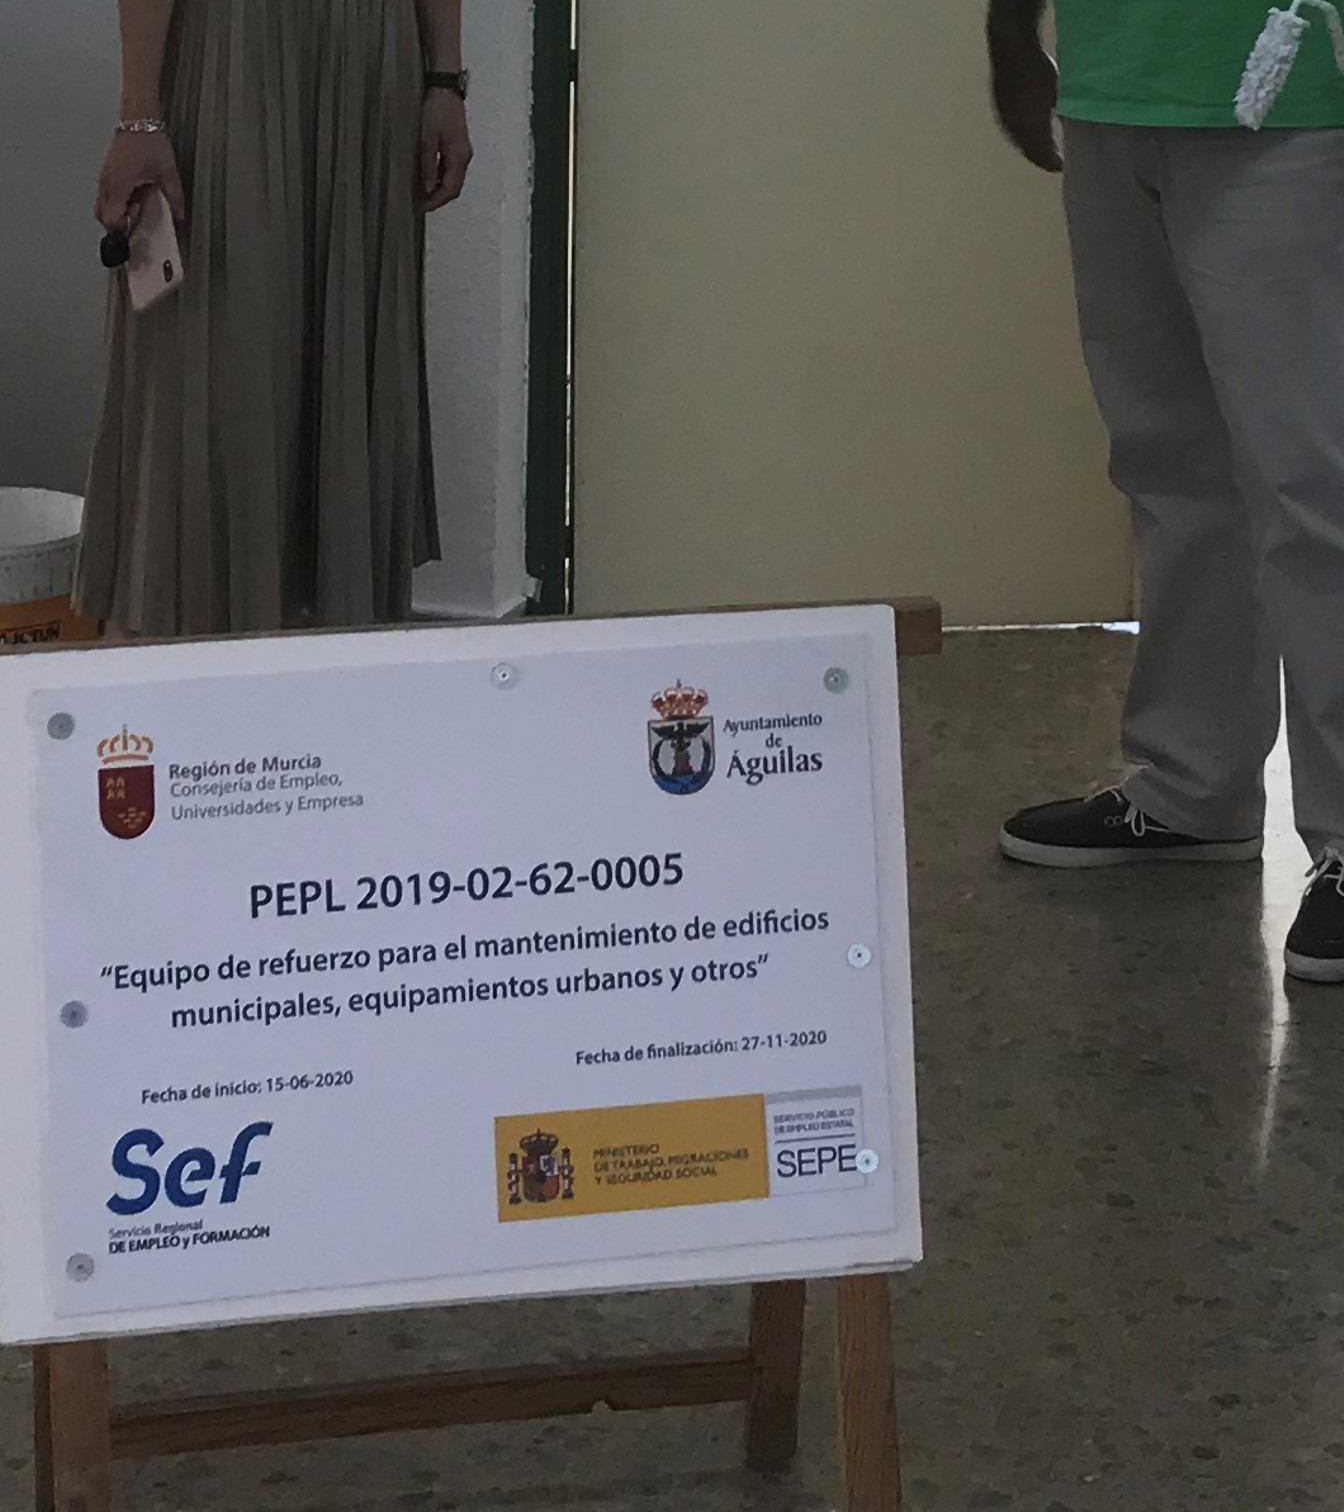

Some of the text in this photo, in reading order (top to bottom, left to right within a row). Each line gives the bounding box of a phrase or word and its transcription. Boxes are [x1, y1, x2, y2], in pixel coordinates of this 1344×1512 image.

[723, 712, 823, 737] Ayuntamiento
[765, 733, 783, 748] de
[168, 753, 322, 782] Región de Murcia
[726, 745, 823, 786] Águilas
[170, 772, 343, 798] Consejería de Empleo,
[171, 793, 364, 821] Universidades y Empresa
[250, 851, 684, 919] PEPL 2019-02-62-0005
[217, 954, 251, 980] de
[258, 948, 371, 977] refuerzo
[378, 943, 437, 971] para
[444, 935, 467, 961] el
[474, 922, 677, 959] mantenimiento
[684, 916, 716, 941] de
[722, 908, 830, 938] edificios
[171, 992, 342, 1029] municipales,
[348, 976, 549, 1017] equipamientos
[555, 967, 663, 996] urbanos
[668, 965, 685, 992] y
[576, 1029, 828, 1066] Fecha de finalización: 27-11-2020
[141, 1070, 354, 1105] Fecha de inicio: 15-06-2020
[106, 1121, 274, 1216] Sef
[777, 1143, 858, 1178] SEPE
[108, 1219, 204, 1240] Servicio Regional
[108, 1225, 271, 1255] DE EMPLEO y FORMACIÓN
